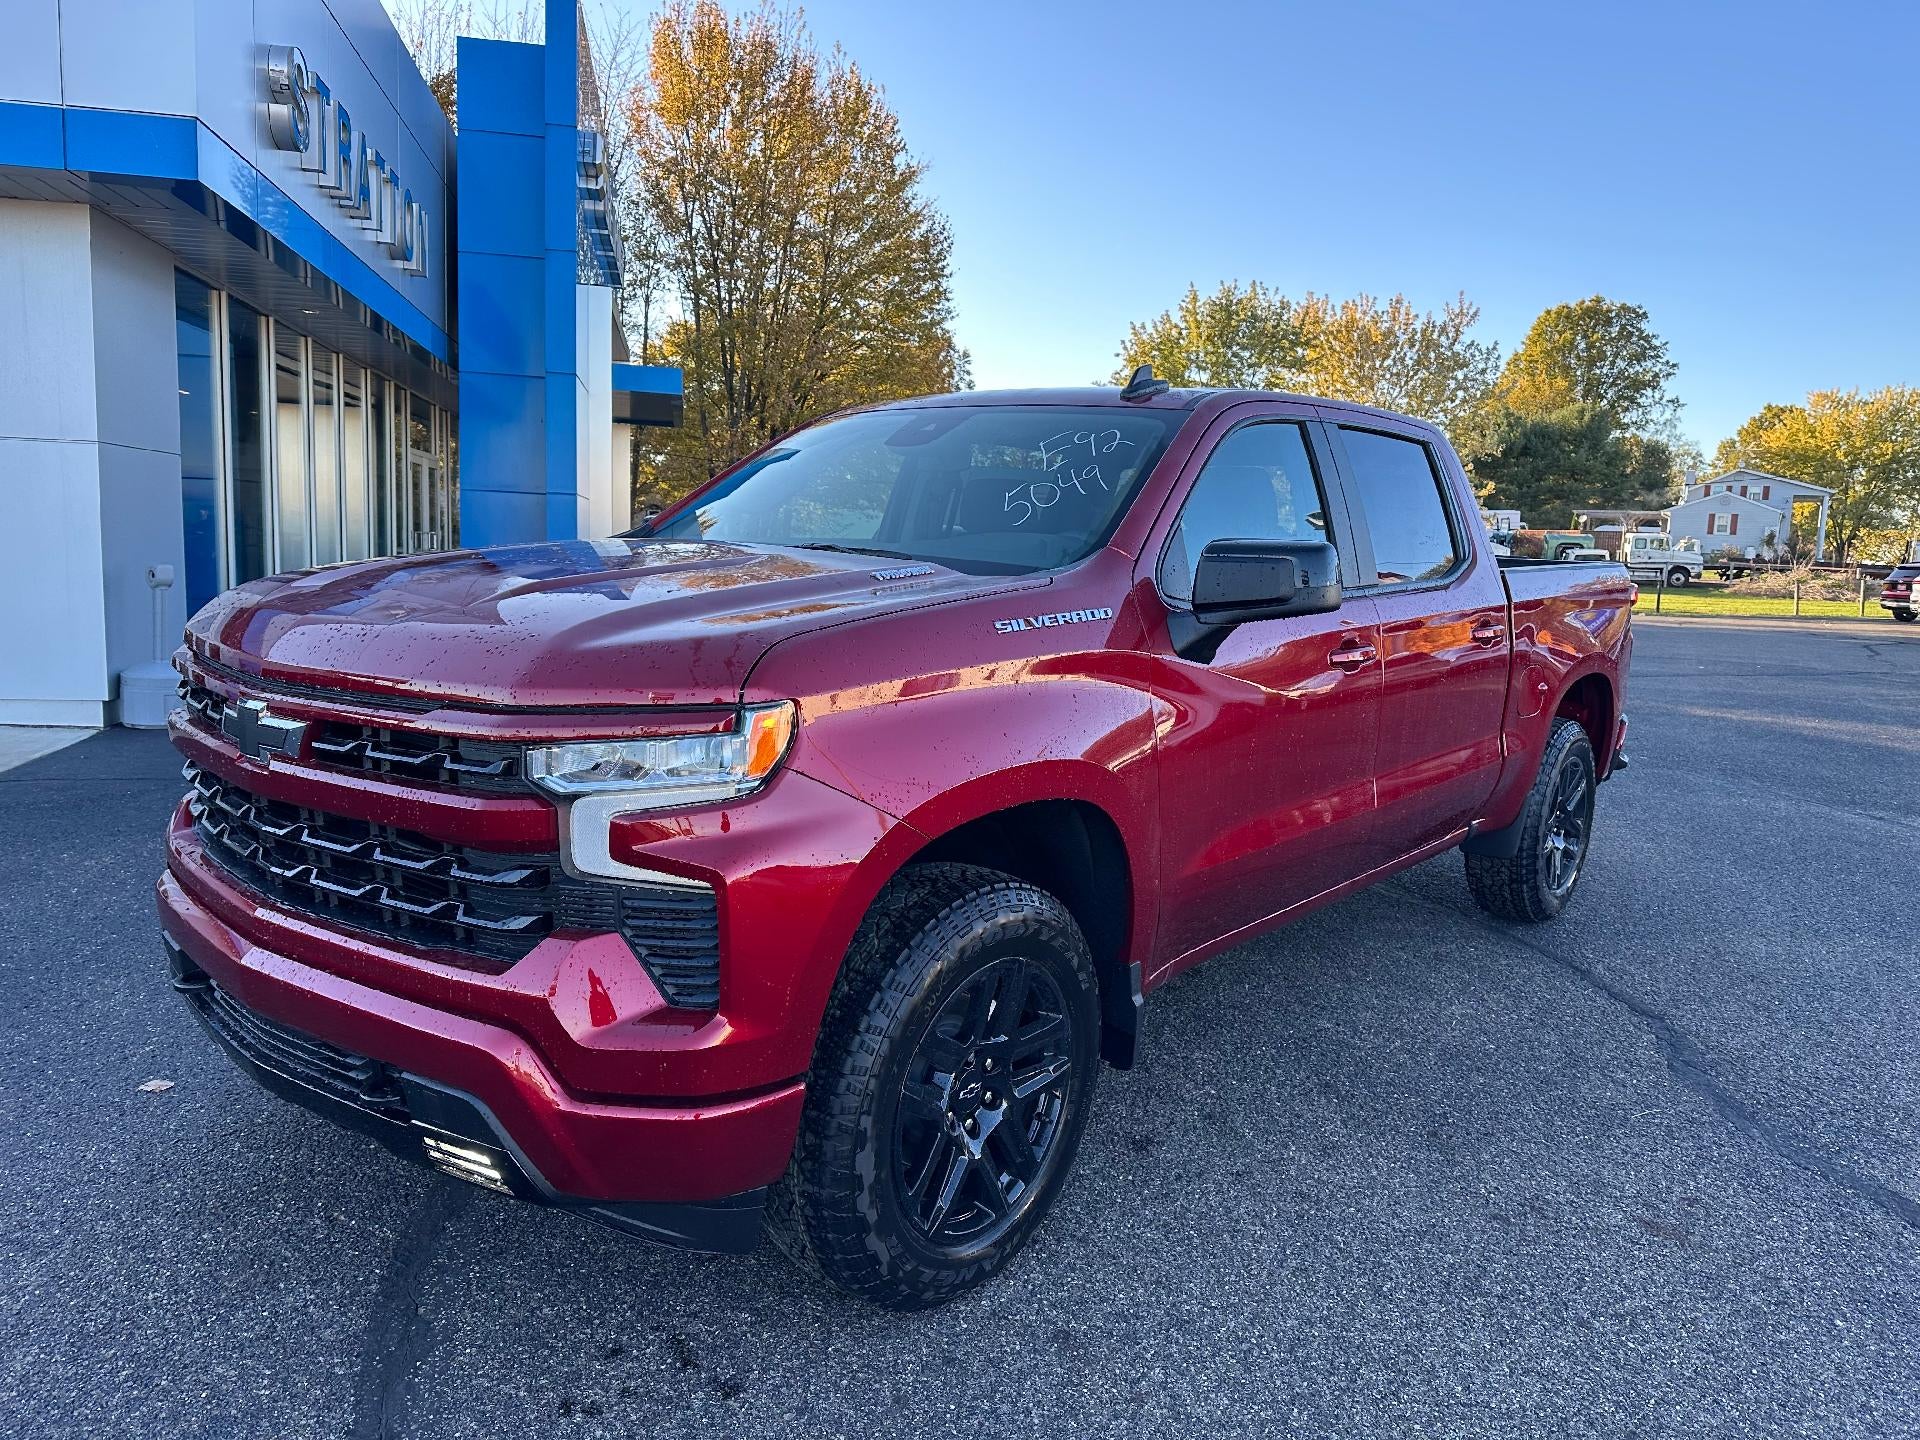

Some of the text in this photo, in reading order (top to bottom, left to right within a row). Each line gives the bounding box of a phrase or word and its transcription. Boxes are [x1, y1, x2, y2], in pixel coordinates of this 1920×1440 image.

[266, 44, 429, 278] STRATTON
[1003, 464, 1109, 526] 5049
[994, 607, 1113, 635] SILVERADO
